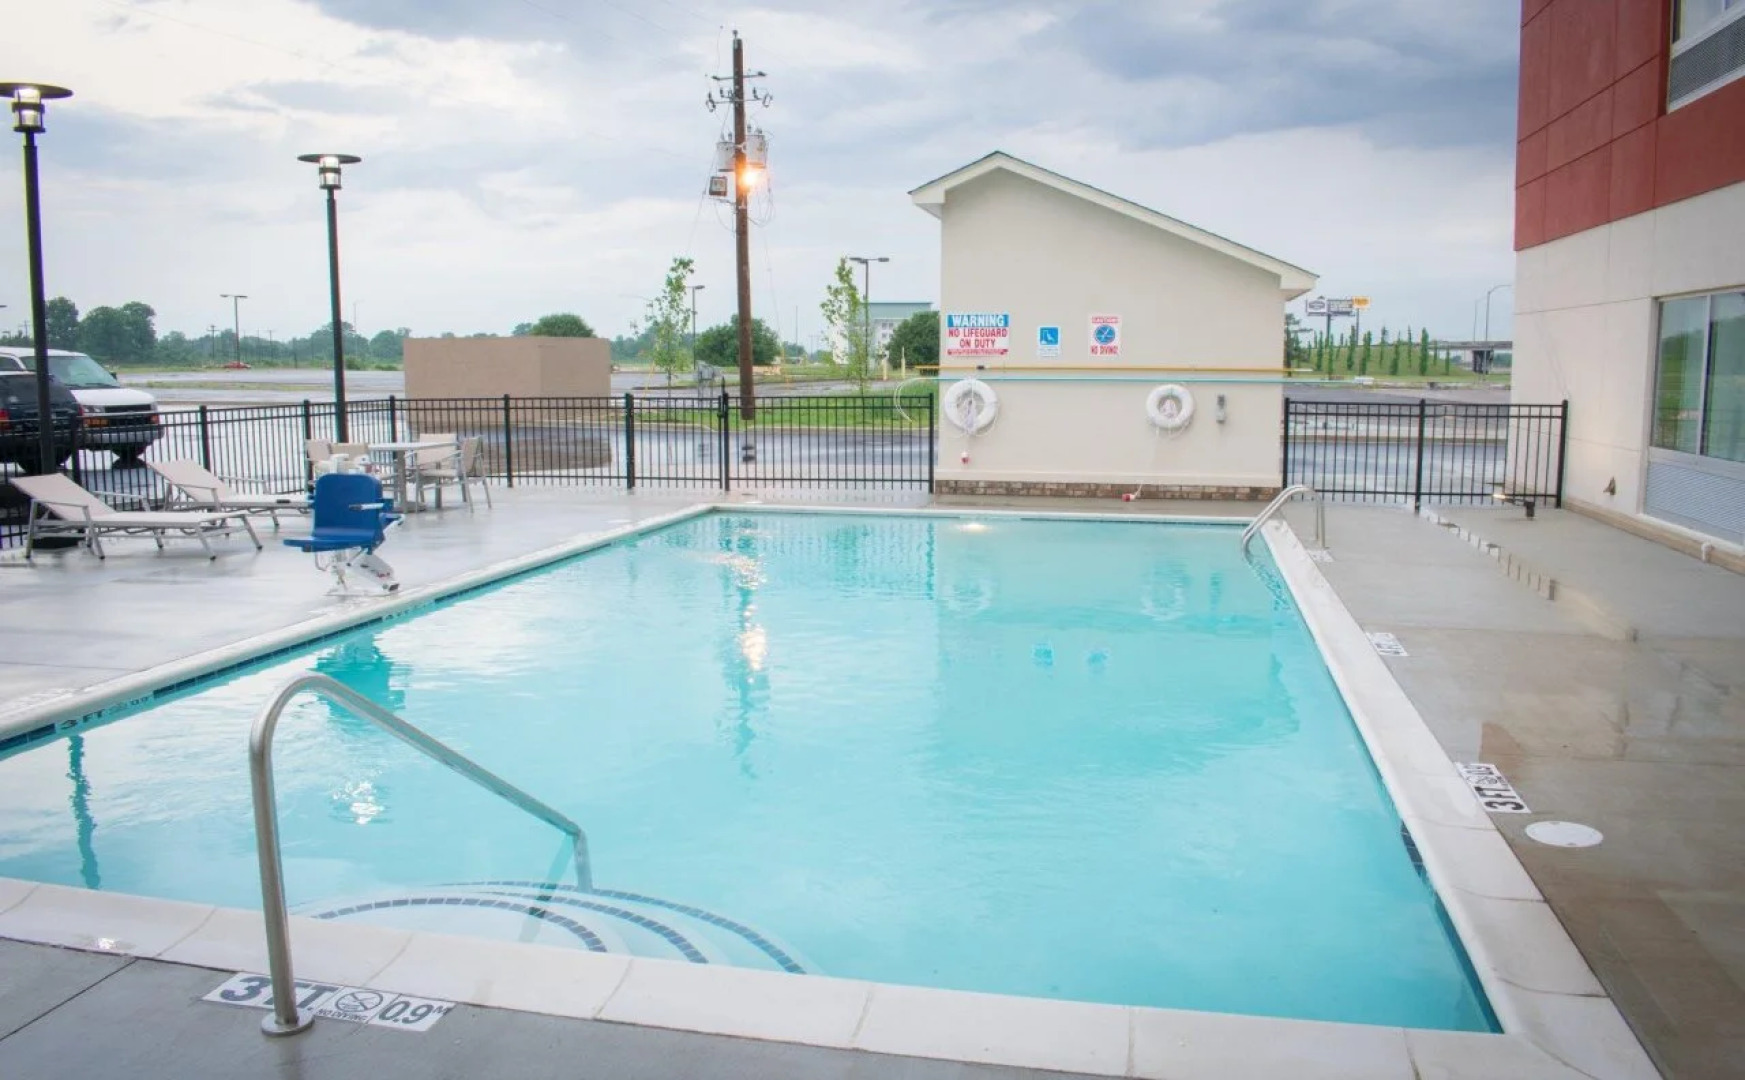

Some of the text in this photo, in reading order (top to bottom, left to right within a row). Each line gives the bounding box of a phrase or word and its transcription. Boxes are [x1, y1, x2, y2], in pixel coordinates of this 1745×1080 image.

[952, 314, 1004, 327] WARNING
[948, 328, 1008, 337] NO LIFEGUARD
[959, 338, 995, 348] ON DUTY
[1484, 801, 1524, 811] 3
[220, 976, 273, 1002] 3
